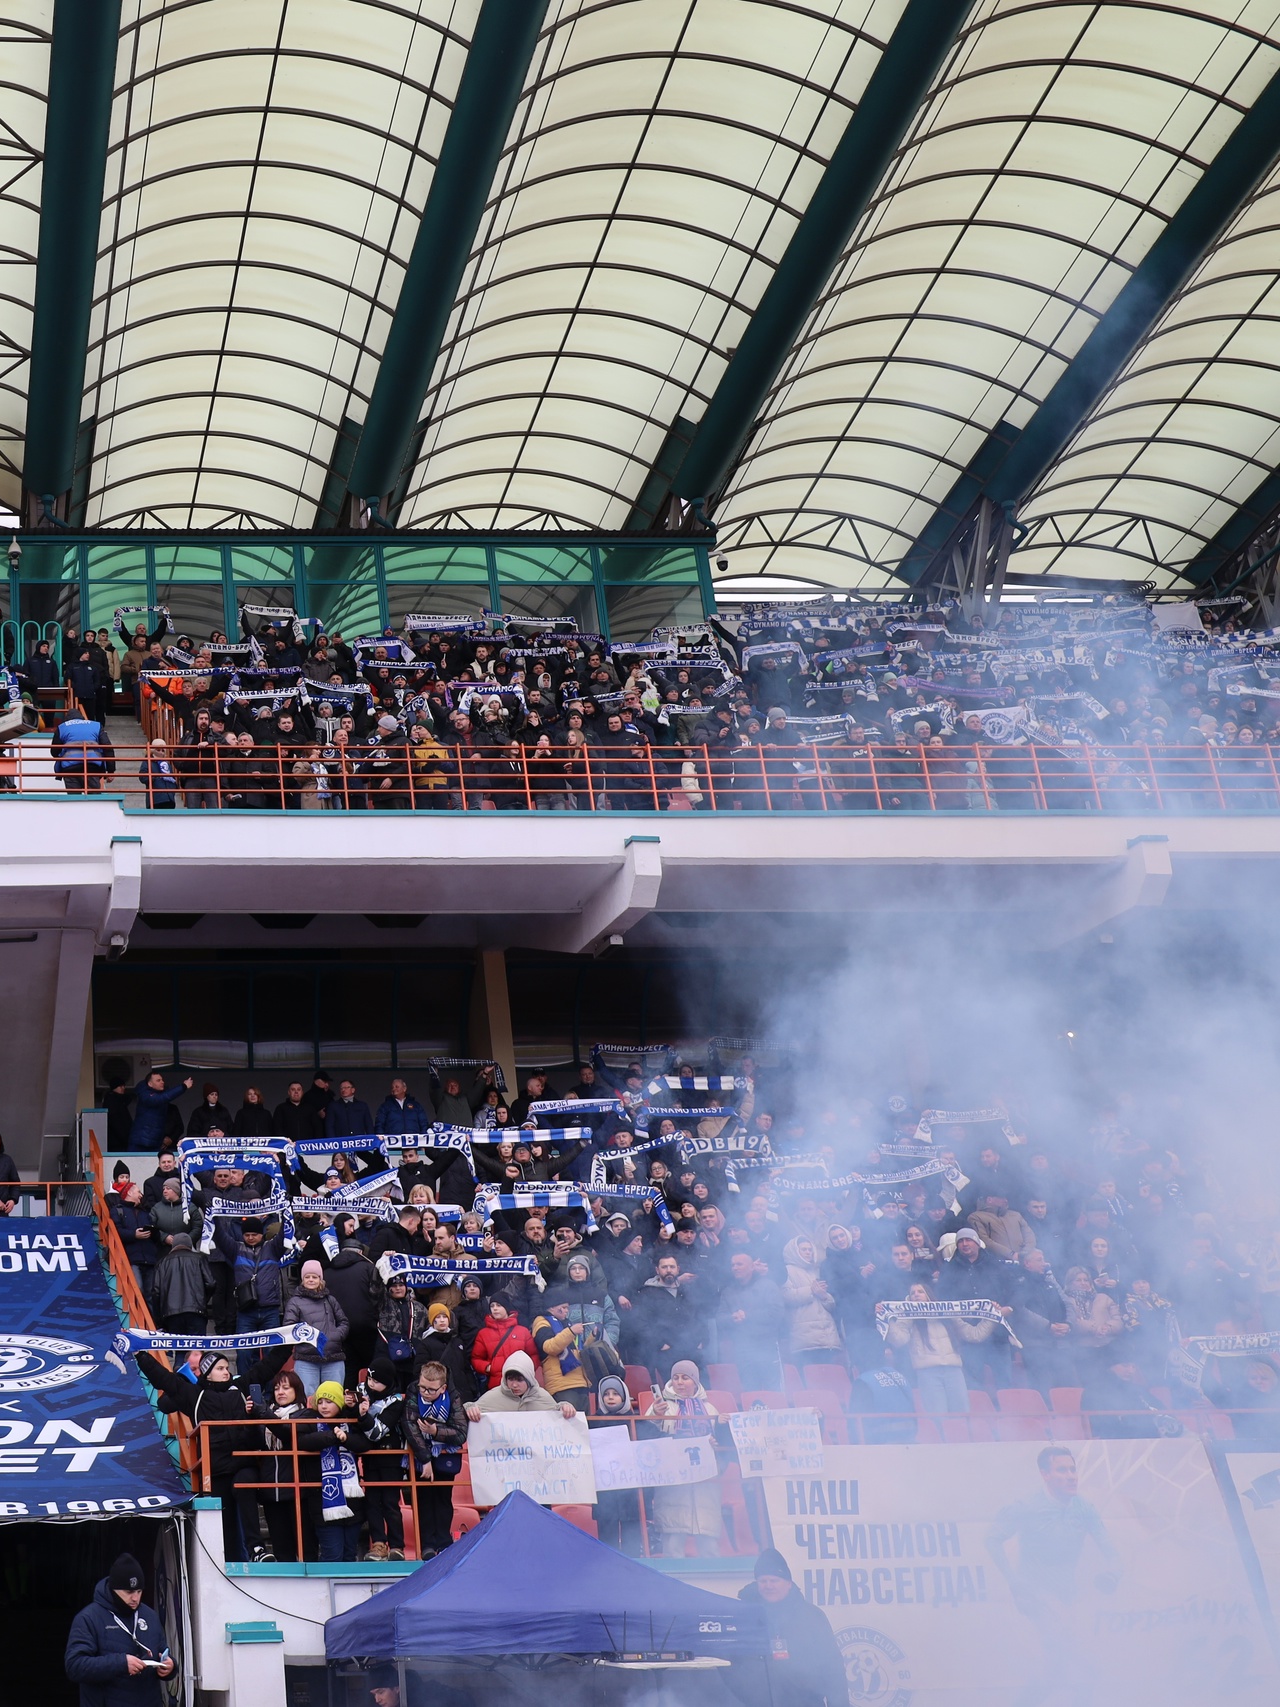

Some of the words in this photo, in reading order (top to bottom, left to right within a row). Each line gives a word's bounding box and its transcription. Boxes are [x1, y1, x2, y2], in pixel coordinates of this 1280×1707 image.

[477, 685, 513, 693] DYNAMO
[300, 1140, 339, 1151] DYNAMO
[341, 1138, 374, 1149] BREST
[525, 1184, 563, 1193] DRIVE
[7, 1234, 83, 1250] НАД
[411, 1258, 448, 1269] ГОРОД
[485, 1258, 523, 1269] БУГОМ
[25, 1336, 75, 1351] CLUB
[151, 1338, 177, 1348] ONE
[178, 1338, 206, 1348] LIFE,
[210, 1338, 235, 1348] ONE
[238, 1336, 270, 1347] CLUB!
[67, 1353, 95, 1362] 60
[17, 1368, 80, 1388] BREST
[485, 1445, 533, 1463] МОЖНО
[543, 1441, 583, 1460] МАЙКУ
[785, 1479, 861, 1517] НАШ
[794, 1522, 962, 1560] ЧЕМПИОН
[804, 1565, 988, 1609] НАВСЕГДА!
[873, 1634, 900, 1660] CLUB
